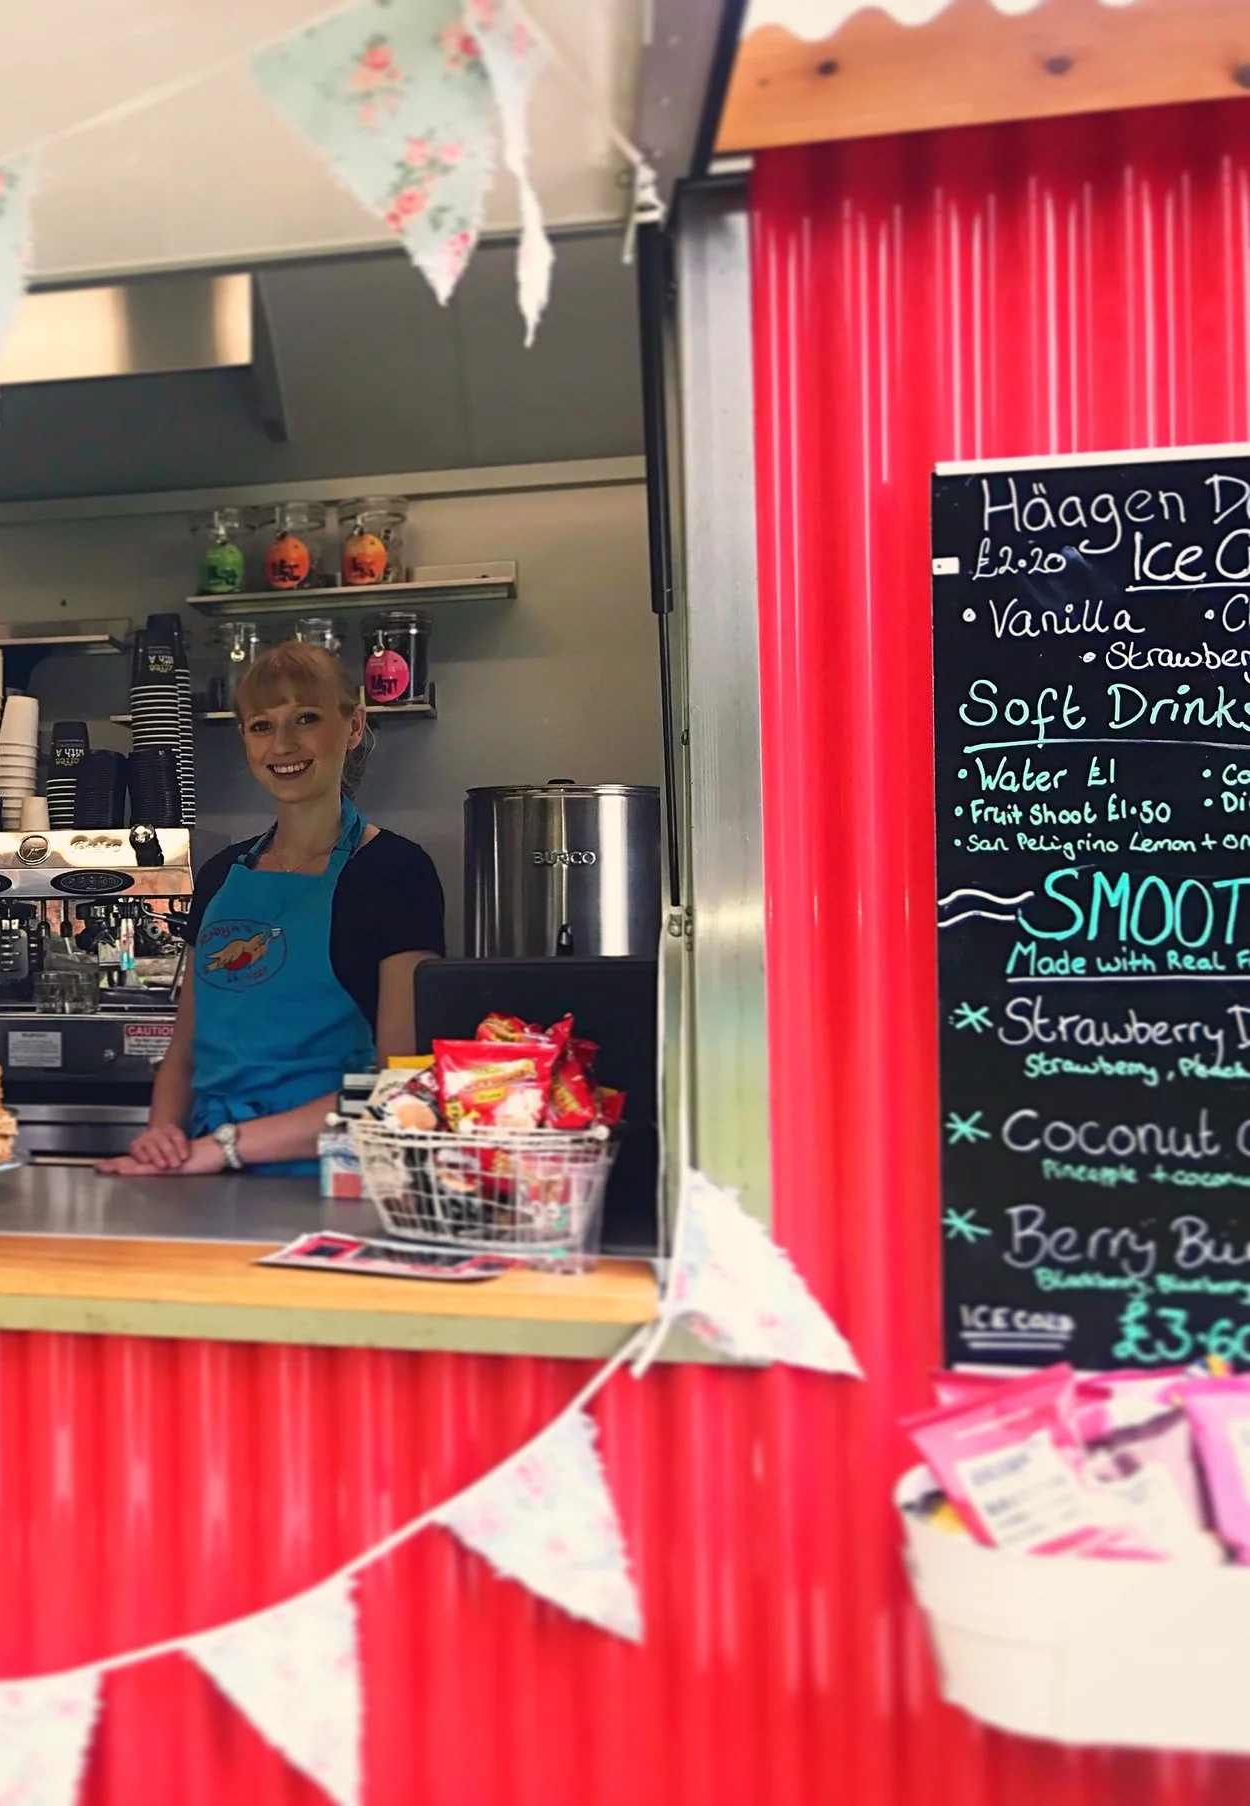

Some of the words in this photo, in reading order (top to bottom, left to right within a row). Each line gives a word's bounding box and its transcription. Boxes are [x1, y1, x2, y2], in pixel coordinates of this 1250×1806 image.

[982, 477, 1186, 554] Häagen
[1205, 474, 1250, 525] D
[1134, 531, 1207, 581] Ice
[1214, 527, 1250, 580] C
[989, 598, 1146, 638] Vanilla
[1221, 593, 1250, 633] C
[1105, 641, 1250, 673] Strawber
[958, 679, 1087, 749] Soft
[975, 756, 1068, 792] Water
[1087, 756, 1116, 787] £1
[970, 799, 1023, 825] Fruit
[1029, 801, 1098, 826] Shoot
[1221, 791, 1250, 813] Di
[532, 851, 596, 866] BURCO
[966, 834, 1010, 853] San
[1129, 831, 1197, 853] Lemon
[1201, 833, 1217, 850] +
[1005, 940, 1087, 977] Made
[1096, 945, 1157, 973] with
[1166, 949, 1227, 972] Real
[997, 995, 1224, 1068] Strawberry
[1001, 1108, 1221, 1159] Coconut
[1003, 1204, 1155, 1279] Berry
[1170, 1215, 1250, 1269] Bu
[960, 1304, 1010, 1330] ICE
